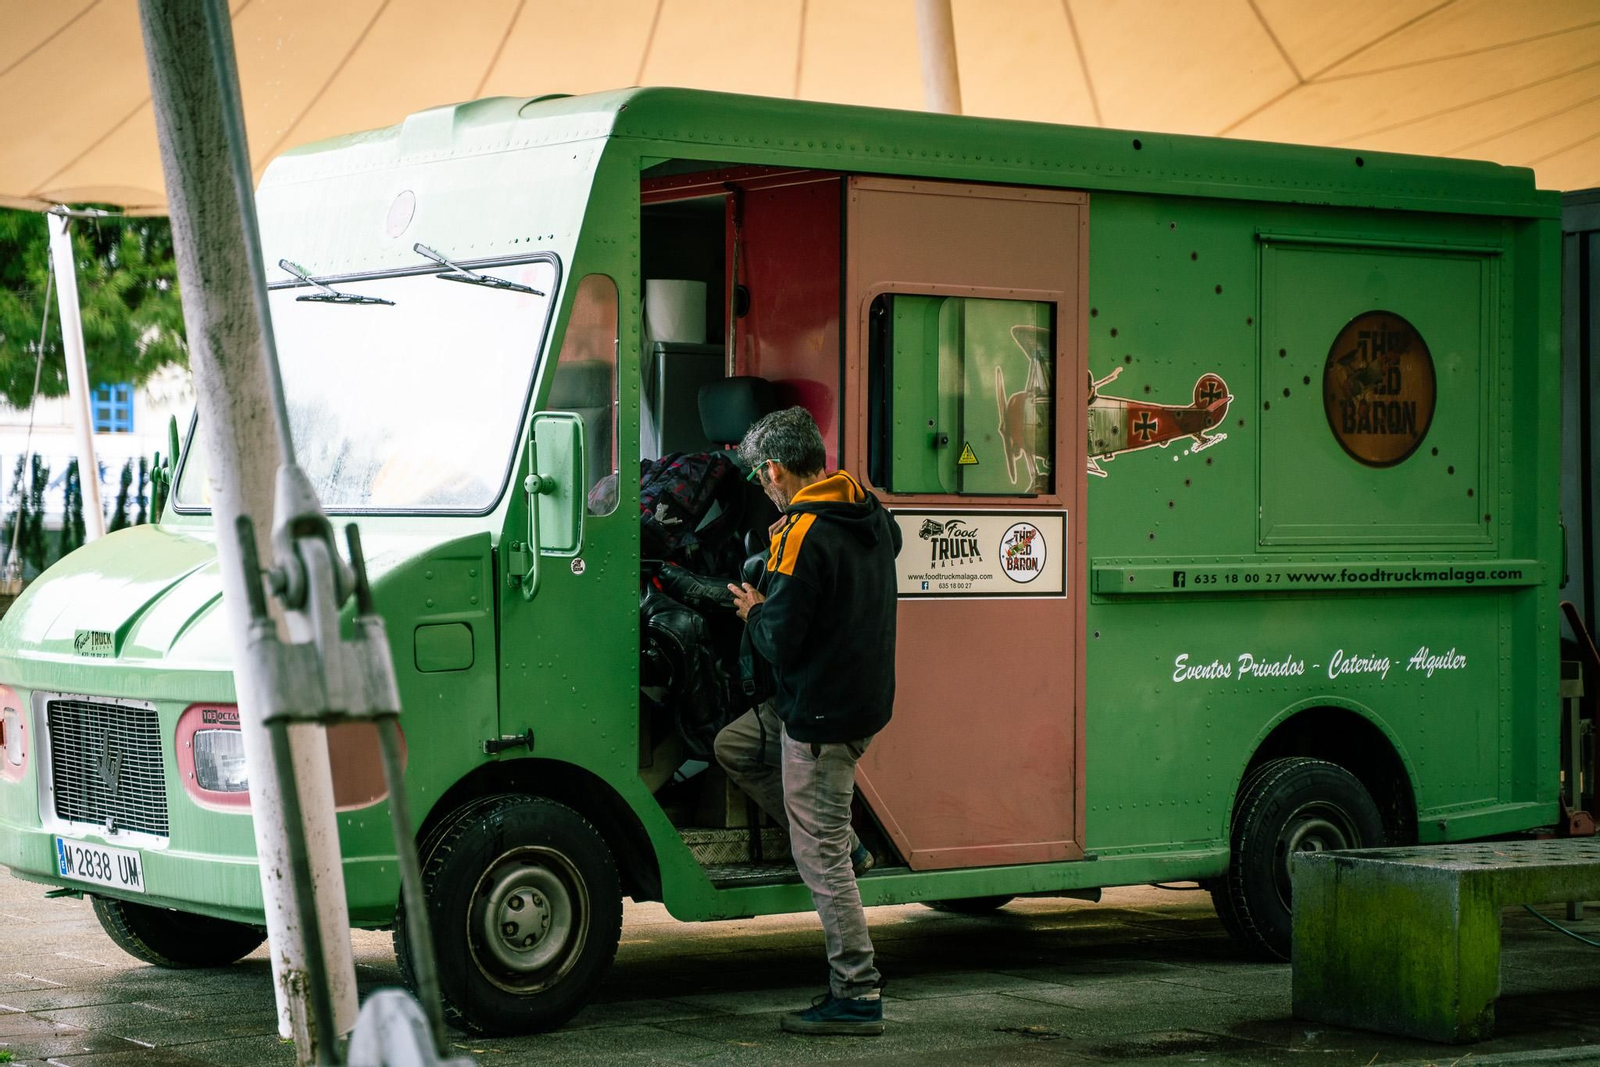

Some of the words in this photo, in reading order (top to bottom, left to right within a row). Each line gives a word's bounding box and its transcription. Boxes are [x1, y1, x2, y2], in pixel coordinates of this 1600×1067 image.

[1341, 400, 1417, 436] BARON
[945, 519, 979, 538] Food
[931, 537, 981, 561] TRUCK
[1006, 557, 1039, 571] BARON
[907, 572, 993, 581] www.foodtruckmalaga.com
[1194, 574, 1217, 583] 635
[1225, 574, 1238, 583] 18
[1245, 574, 1259, 583] 00
[1266, 574, 1281, 583] 27
[1287, 567, 1522, 583] www.foodtruckmalaga.com
[91, 631, 112, 645] TRUCK
[1173, 653, 1232, 682] Eventos
[1238, 653, 1305, 680] Privados
[1328, 649, 1391, 680] Catering
[1406, 646, 1467, 678] Alquiler
[203, 710, 217, 720] 103
[64, 845, 74, 873] M
[76, 848, 112, 881] 2838
[117, 855, 139, 886] UM
